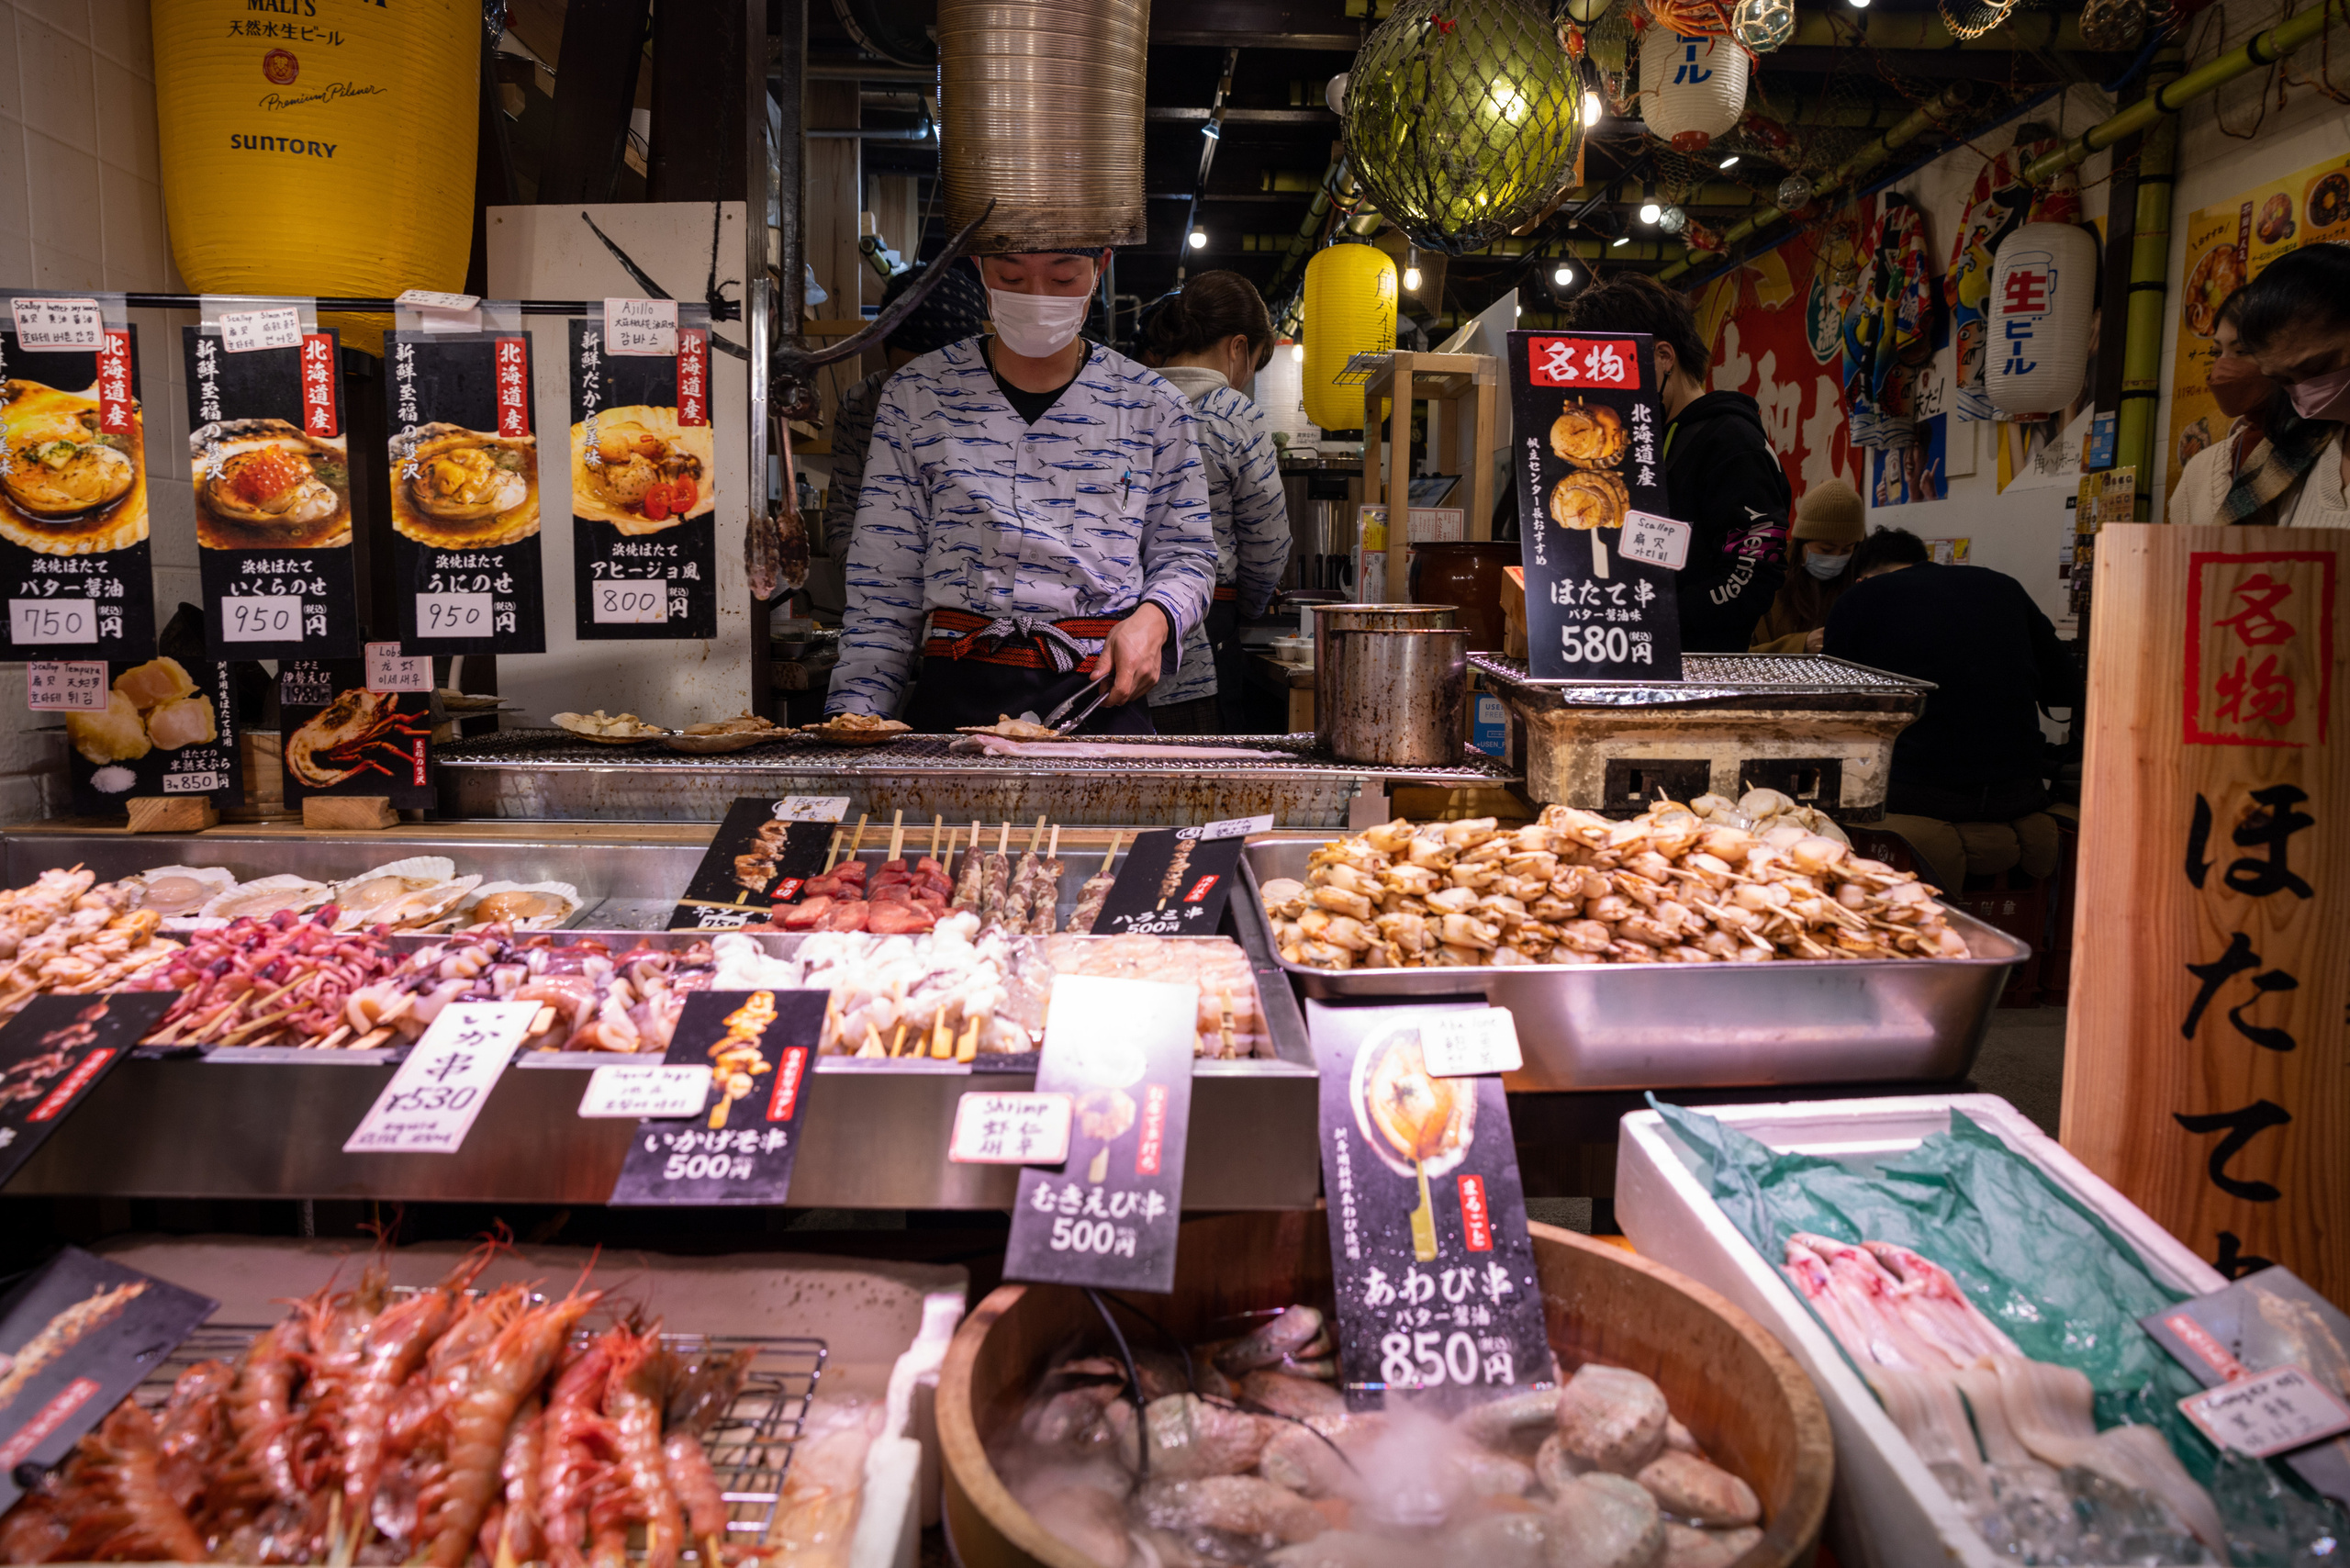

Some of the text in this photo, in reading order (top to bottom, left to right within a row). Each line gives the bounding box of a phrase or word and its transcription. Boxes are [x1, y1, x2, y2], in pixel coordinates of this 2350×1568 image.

[227, 20, 344, 46] 天然水生ビール
[259, 82, 387, 111] Premium Pilsner
[230, 134, 338, 158] SUNTORY
[2003, 271, 2047, 375] 生ビール
[1538, 342, 1625, 382] 名物
[101, 334, 129, 427] 北海道産
[305, 340, 331, 429] 北海道産
[500, 343, 523, 430] 北海道産
[681, 334, 703, 420] 北海道産
[1631, 403, 1657, 487] 北海道産
[1527, 437, 1548, 566] 帆立センター長おすすめ
[435, 554, 504, 568] 浜焼ほたて
[612, 542, 678, 557] 浜焼ほたて
[31, 558, 108, 574] 浜焼ほたて
[241, 559, 313, 574] 浜焼ほたて
[590, 561, 700, 581] アヒージョ風
[19, 577, 124, 598] バター醤油
[230, 577, 327, 597] いくらのせ
[428, 572, 514, 594] うにのせ
[1550, 577, 1656, 609] ほたて串
[603, 589, 655, 612] 800
[26, 609, 82, 637] 750
[235, 605, 289, 633] 950
[430, 603, 480, 629] 950
[1568, 608, 1642, 622] バター醤油味
[2212, 573, 2295, 725] 名物
[644, 1127, 787, 1155] いかげそ串
[1030, 1182, 1166, 1225] むきえび串
[1363, 1261, 1514, 1305] あわび串
[1395, 1304, 1491, 1327] バター醤油
